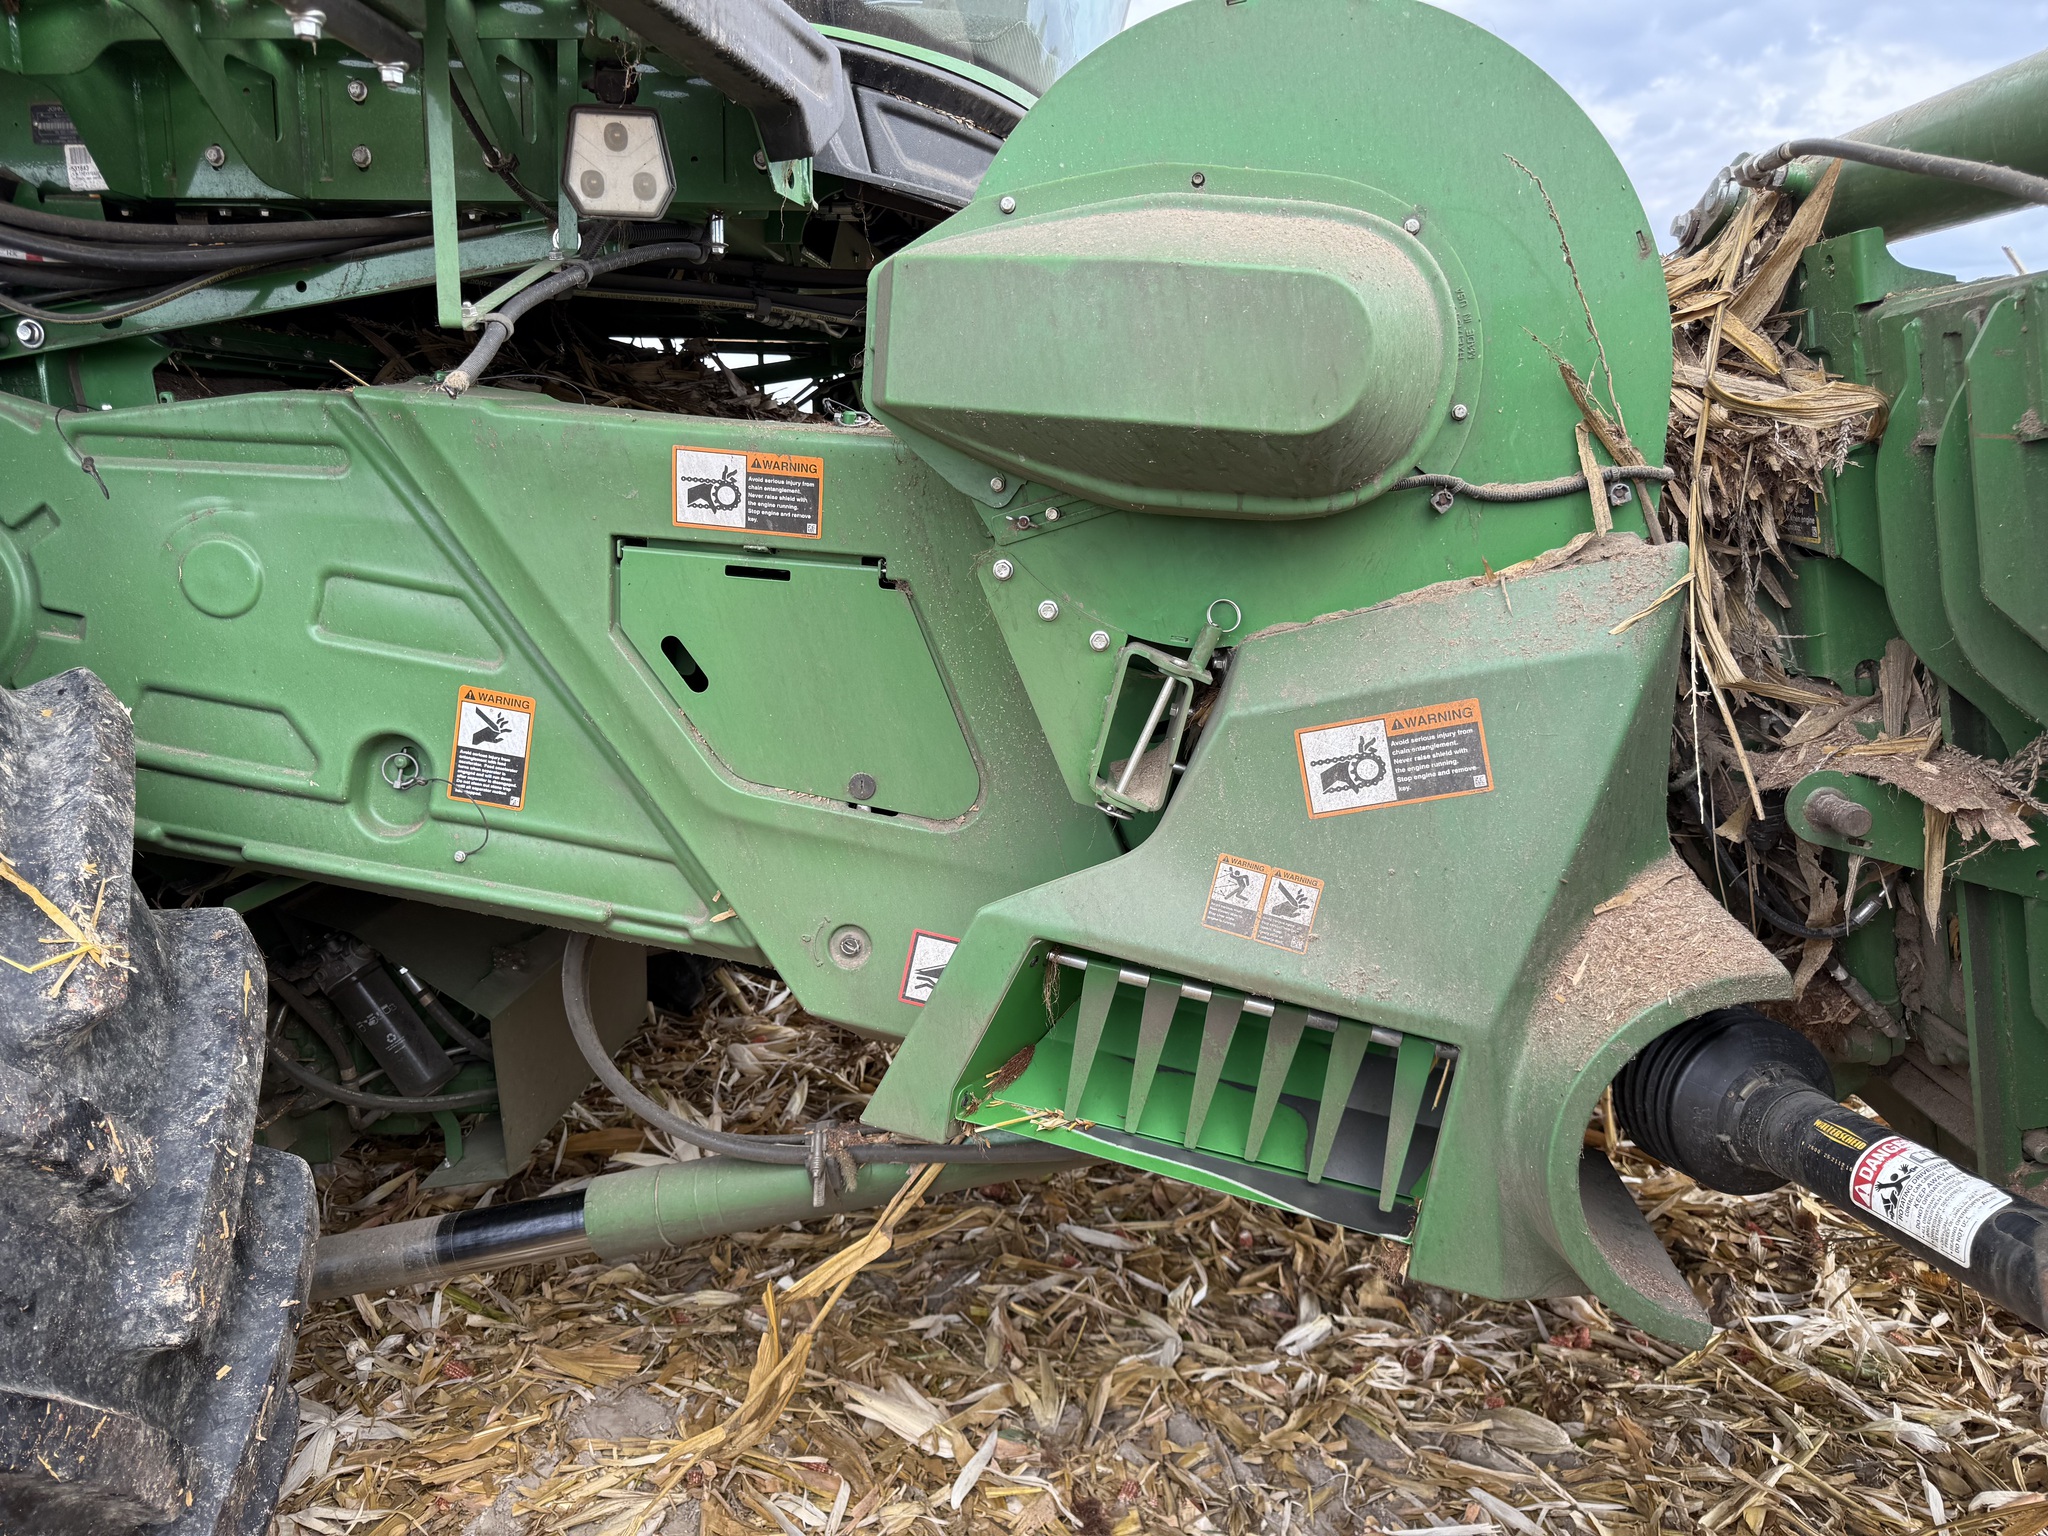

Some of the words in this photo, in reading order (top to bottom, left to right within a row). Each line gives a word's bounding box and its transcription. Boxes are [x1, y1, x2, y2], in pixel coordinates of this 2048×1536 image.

[762, 460, 817, 474] WARNING
[764, 486, 802, 495] entanglement.
[777, 503, 798, 511] running.
[479, 692, 530, 709] WARNING
[1404, 707, 1473, 729] WARNING
[1390, 738, 1409, 747] Avoid
[1410, 734, 1435, 743] serious
[1436, 730, 1456, 740] injury
[1457, 727, 1473, 735] from
[1392, 747, 1411, 756] chain
[1411, 739, 1459, 754] entanglement.
[1393, 756, 1413, 765] Never
[1414, 753, 1431, 761] raise
[1432, 750, 1453, 758] shield
[1453, 747, 1468, 755] with
[1407, 762, 1431, 773] engine
[1431, 758, 1459, 769] running.
[1396, 775, 1413, 784] Stop
[1413, 771, 1437, 781] engine
[1451, 765, 1477, 774] remove
[1398, 784, 1412, 793] key.
[1231, 857, 1265, 872] WARNING
[1283, 872, 1318, 886] WARNING
[1813, 1118, 1867, 1150] WALTERSCHEID
[1913, 1187, 1927, 1209] KEEP
[1926, 1171, 1949, 1188] AWAY!
[1921, 1180, 1942, 1206] OPERATE
[1898, 1184, 1914, 1221] ROTATING
[1916, 1205, 1924, 1219] NOT
[1915, 1220, 1921, 1230] DO
[1956, 1228, 1964, 1242] NOT
[1955, 1244, 1960, 1253] DO
